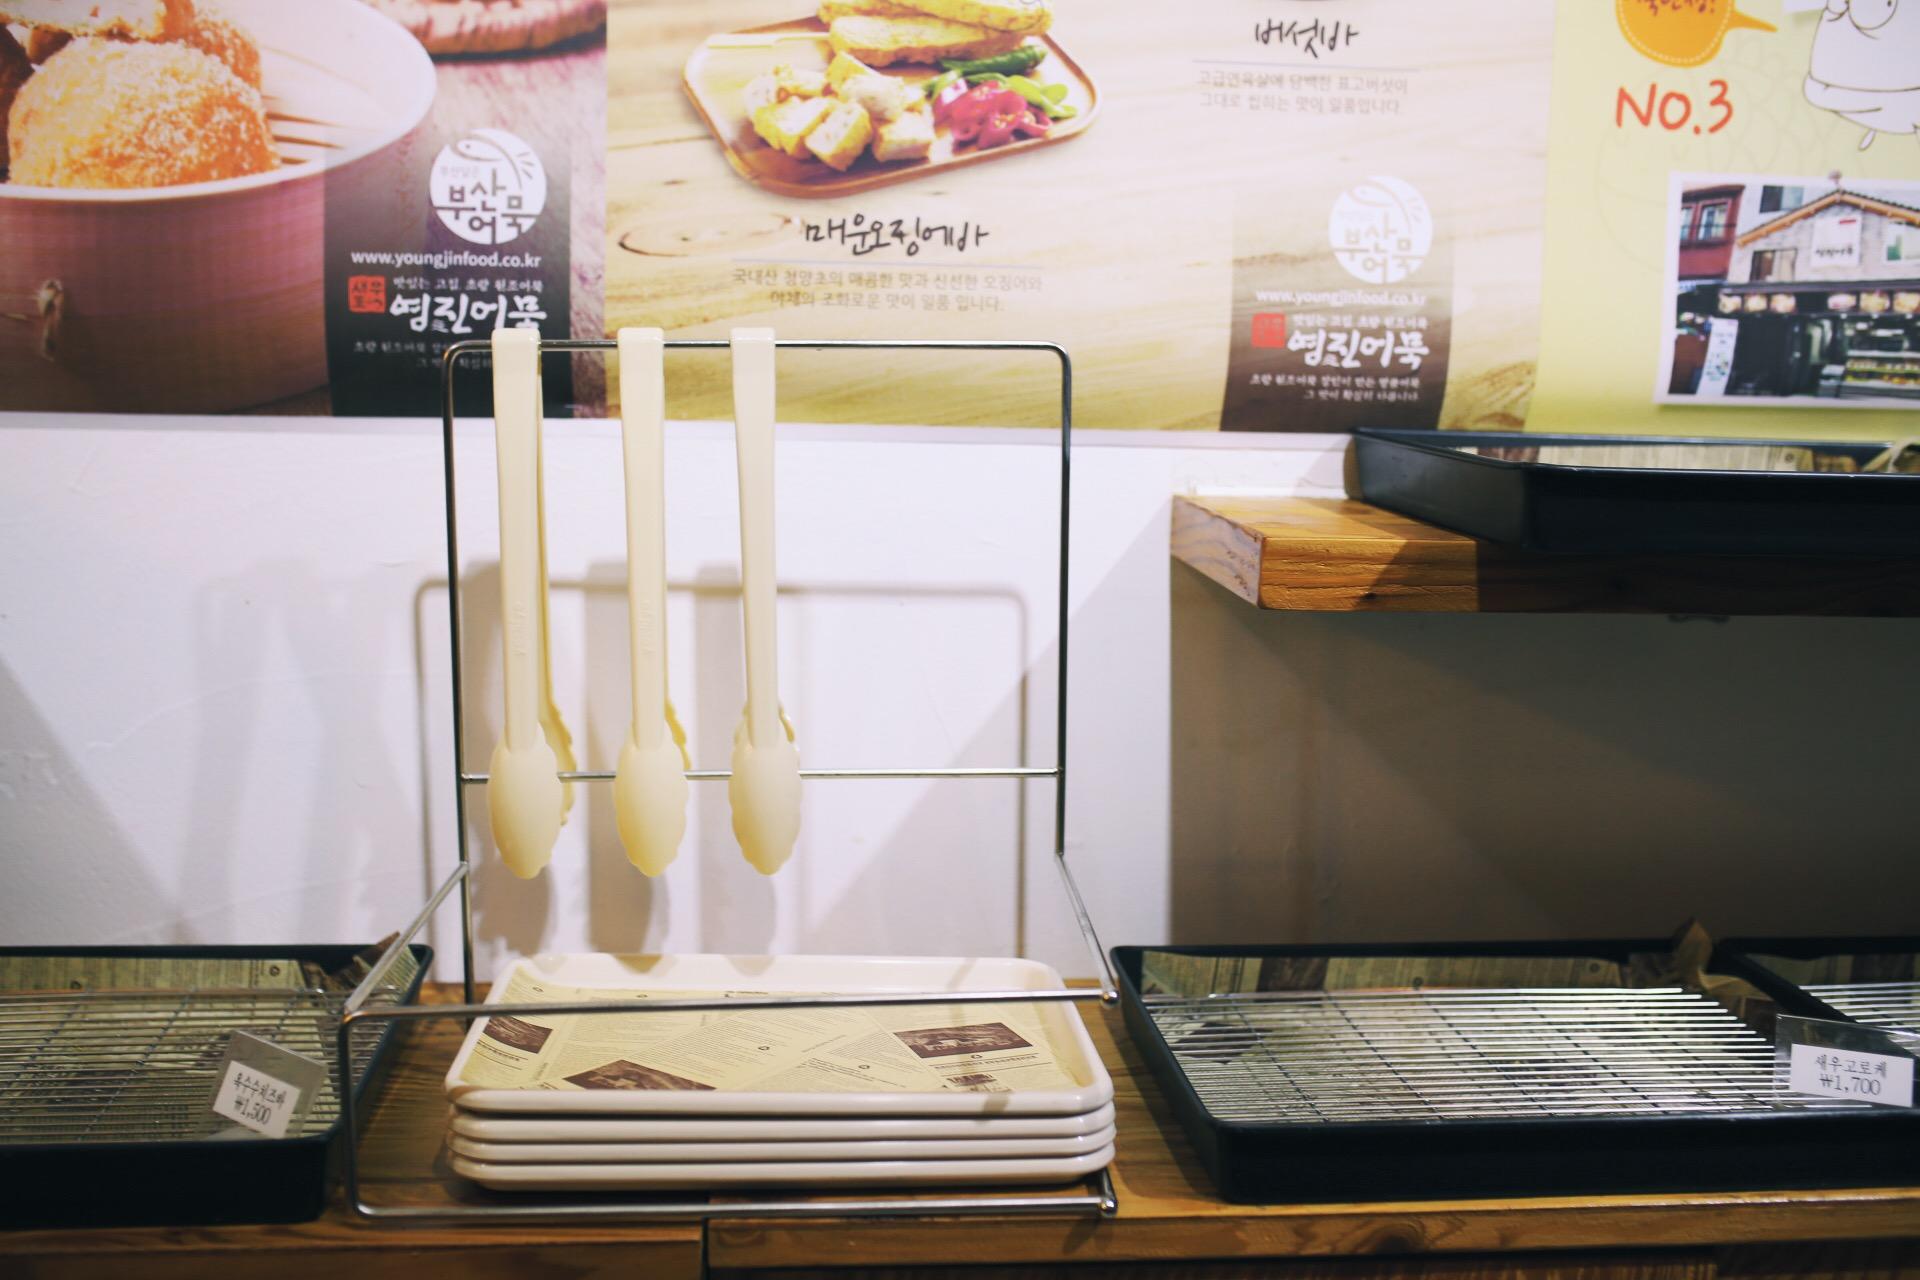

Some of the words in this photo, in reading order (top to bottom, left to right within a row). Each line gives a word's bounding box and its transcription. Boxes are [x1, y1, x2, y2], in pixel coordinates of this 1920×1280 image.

[1255, 18, 1359, 58] 버섯바
[1616, 79, 1733, 135] NO.3
[351, 250, 542, 269] www.youngjinfood.co.kr
[732, 268, 778, 286] 국내산
[784, 270, 843, 288] 청양초의
[848, 272, 894, 290] 매콤한
[899, 273, 929, 290] 맛과
[933, 275, 978, 292] 신선한
[983, 276, 1043, 293] 오징어와
[823, 292, 881, 310] 조화로운
[887, 294, 918, 310] 맛이
[921, 295, 951, 312] 일품
[1256, 290, 1427, 306] www.youngjinfood.co.kr
[389, 294, 548, 334] 영진어묵
[1287, 328, 1430, 371] 영진어묵
[1815, 1054, 1888, 1079] 새우고로케
[233, 1072, 287, 1109] 옥수수치즈바
[1819, 1073, 1881, 1096] ₩1,700
